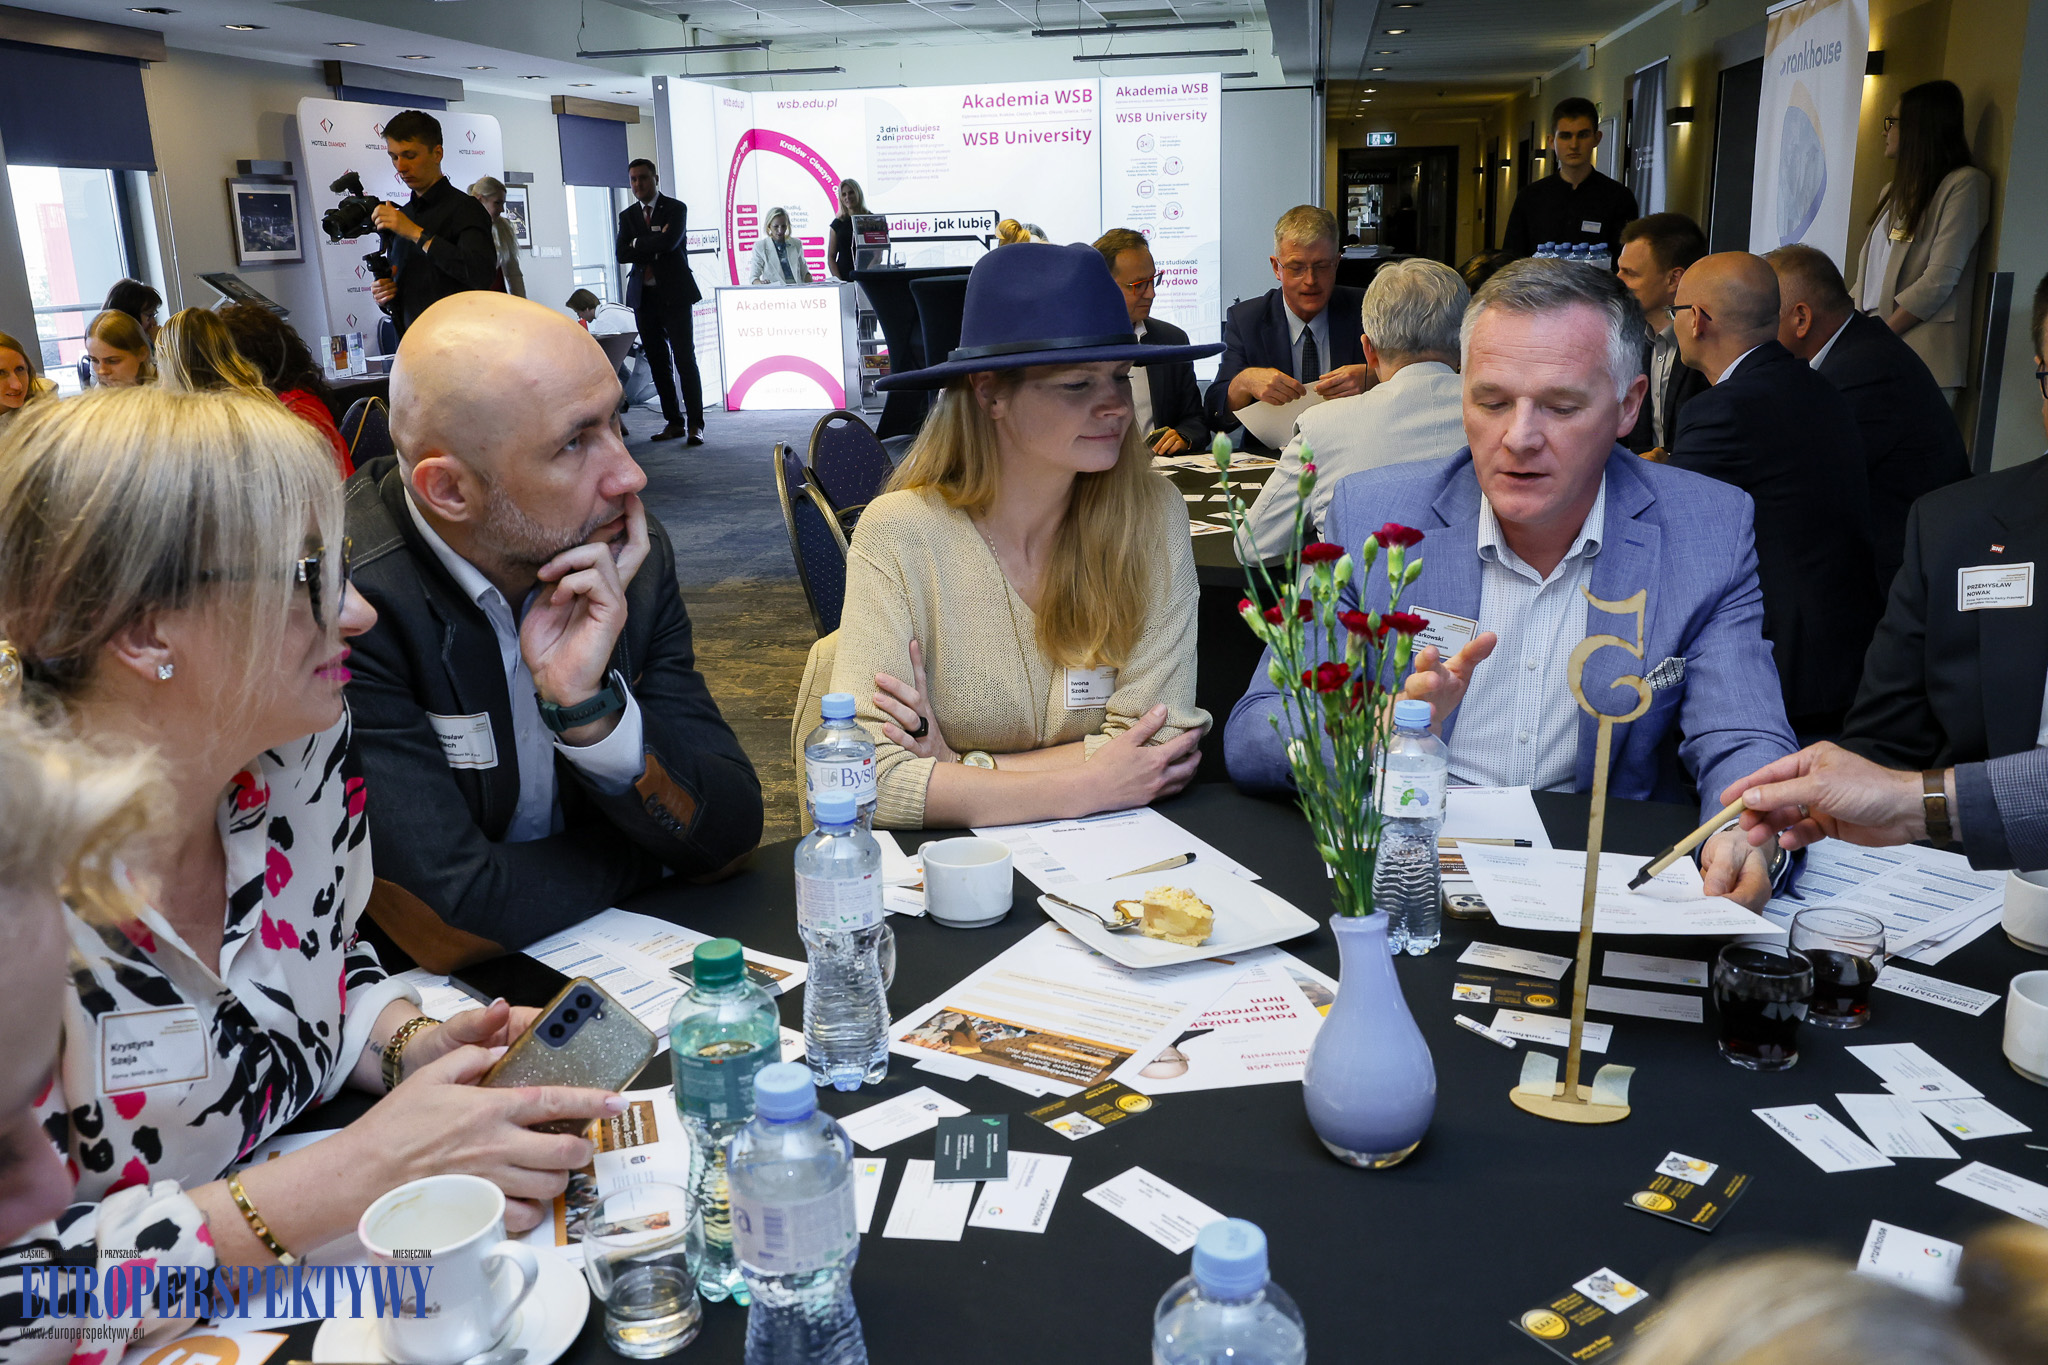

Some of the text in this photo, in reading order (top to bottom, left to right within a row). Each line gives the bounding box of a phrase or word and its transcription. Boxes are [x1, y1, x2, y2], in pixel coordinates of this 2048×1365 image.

[1115, 83, 1209, 97] Akademia WSB
[776, 98, 838, 111] wsb.edu.pl
[962, 88, 1093, 109] Akademia WSB
[1115, 109, 1208, 123] WSB University
[885, 125, 899, 133] dni
[900, 124, 940, 133] studiujesz
[896, 133, 935, 142] pracujesz
[962, 127, 1092, 147] WSB University
[779, 139, 833, 184] Kraków Cieszyn
[933, 218, 955, 233] jak
[958, 216, 992, 231] lubię
[1166, 258, 1198, 266] studiować
[736, 298, 827, 311] Akademia WSB
[737, 326, 828, 338] WSB University
[1966, 582, 2012, 590] PRZEMYSŁAW
[1250, 995, 1285, 1004] firm
[1263, 1003, 1290, 1012] dla
[1243, 1012, 1297, 1023] Pakiet
[110, 1040, 154, 1053] Krystyna
